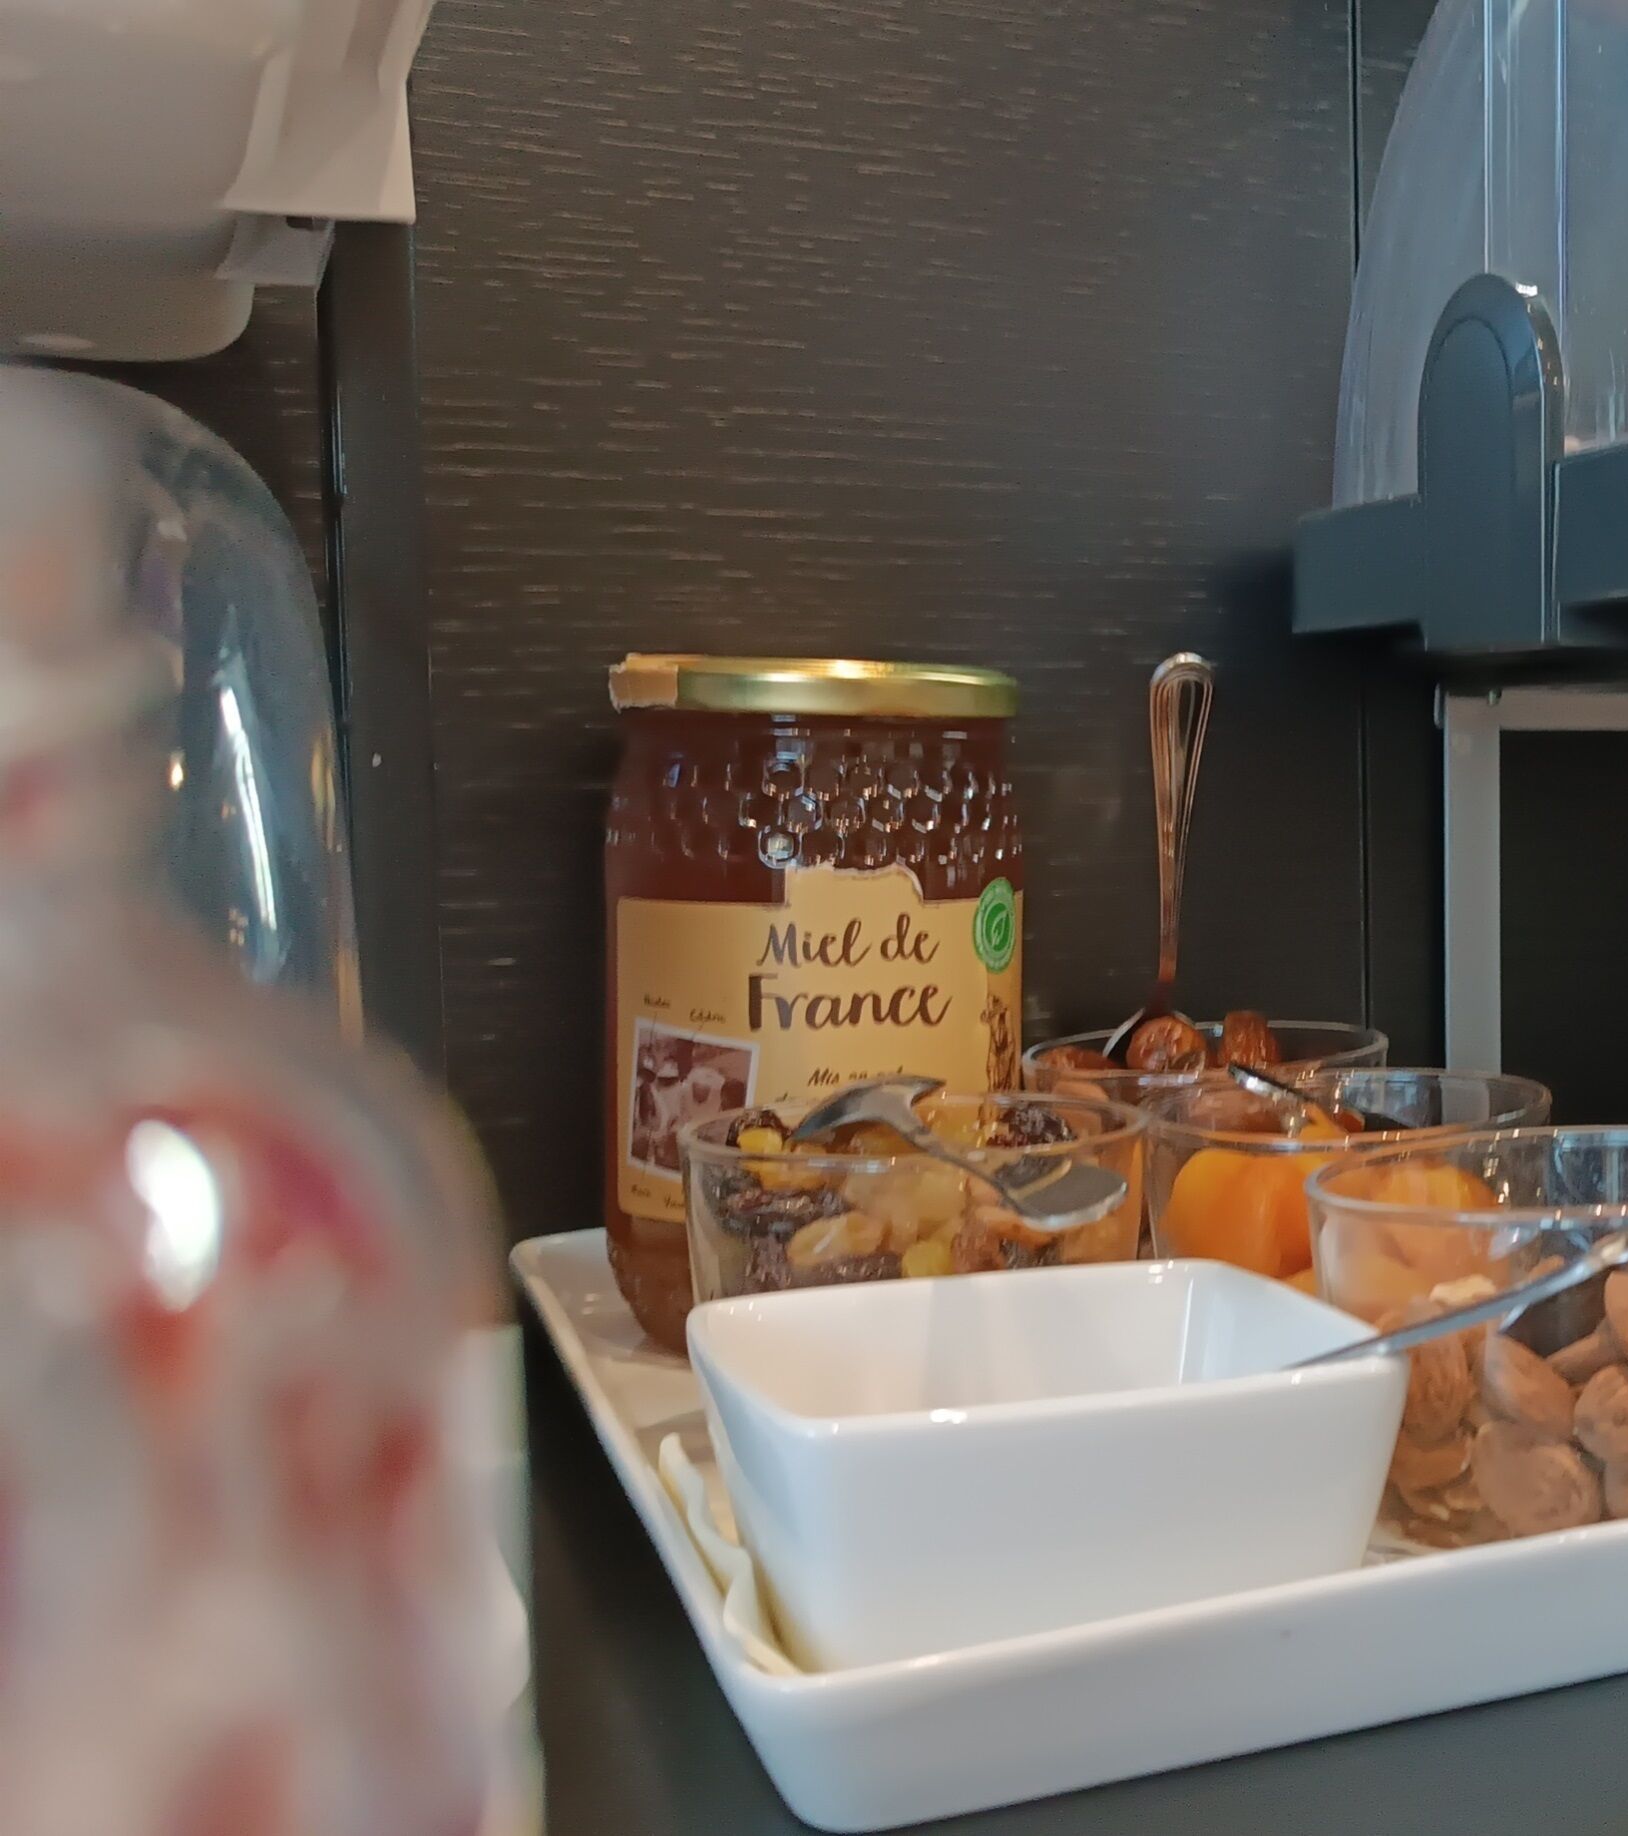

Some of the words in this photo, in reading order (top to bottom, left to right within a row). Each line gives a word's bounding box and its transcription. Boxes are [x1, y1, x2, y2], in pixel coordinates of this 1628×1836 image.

[757, 918, 872, 968] Miel
[880, 912, 940, 964] de
[748, 973, 952, 1032] France
